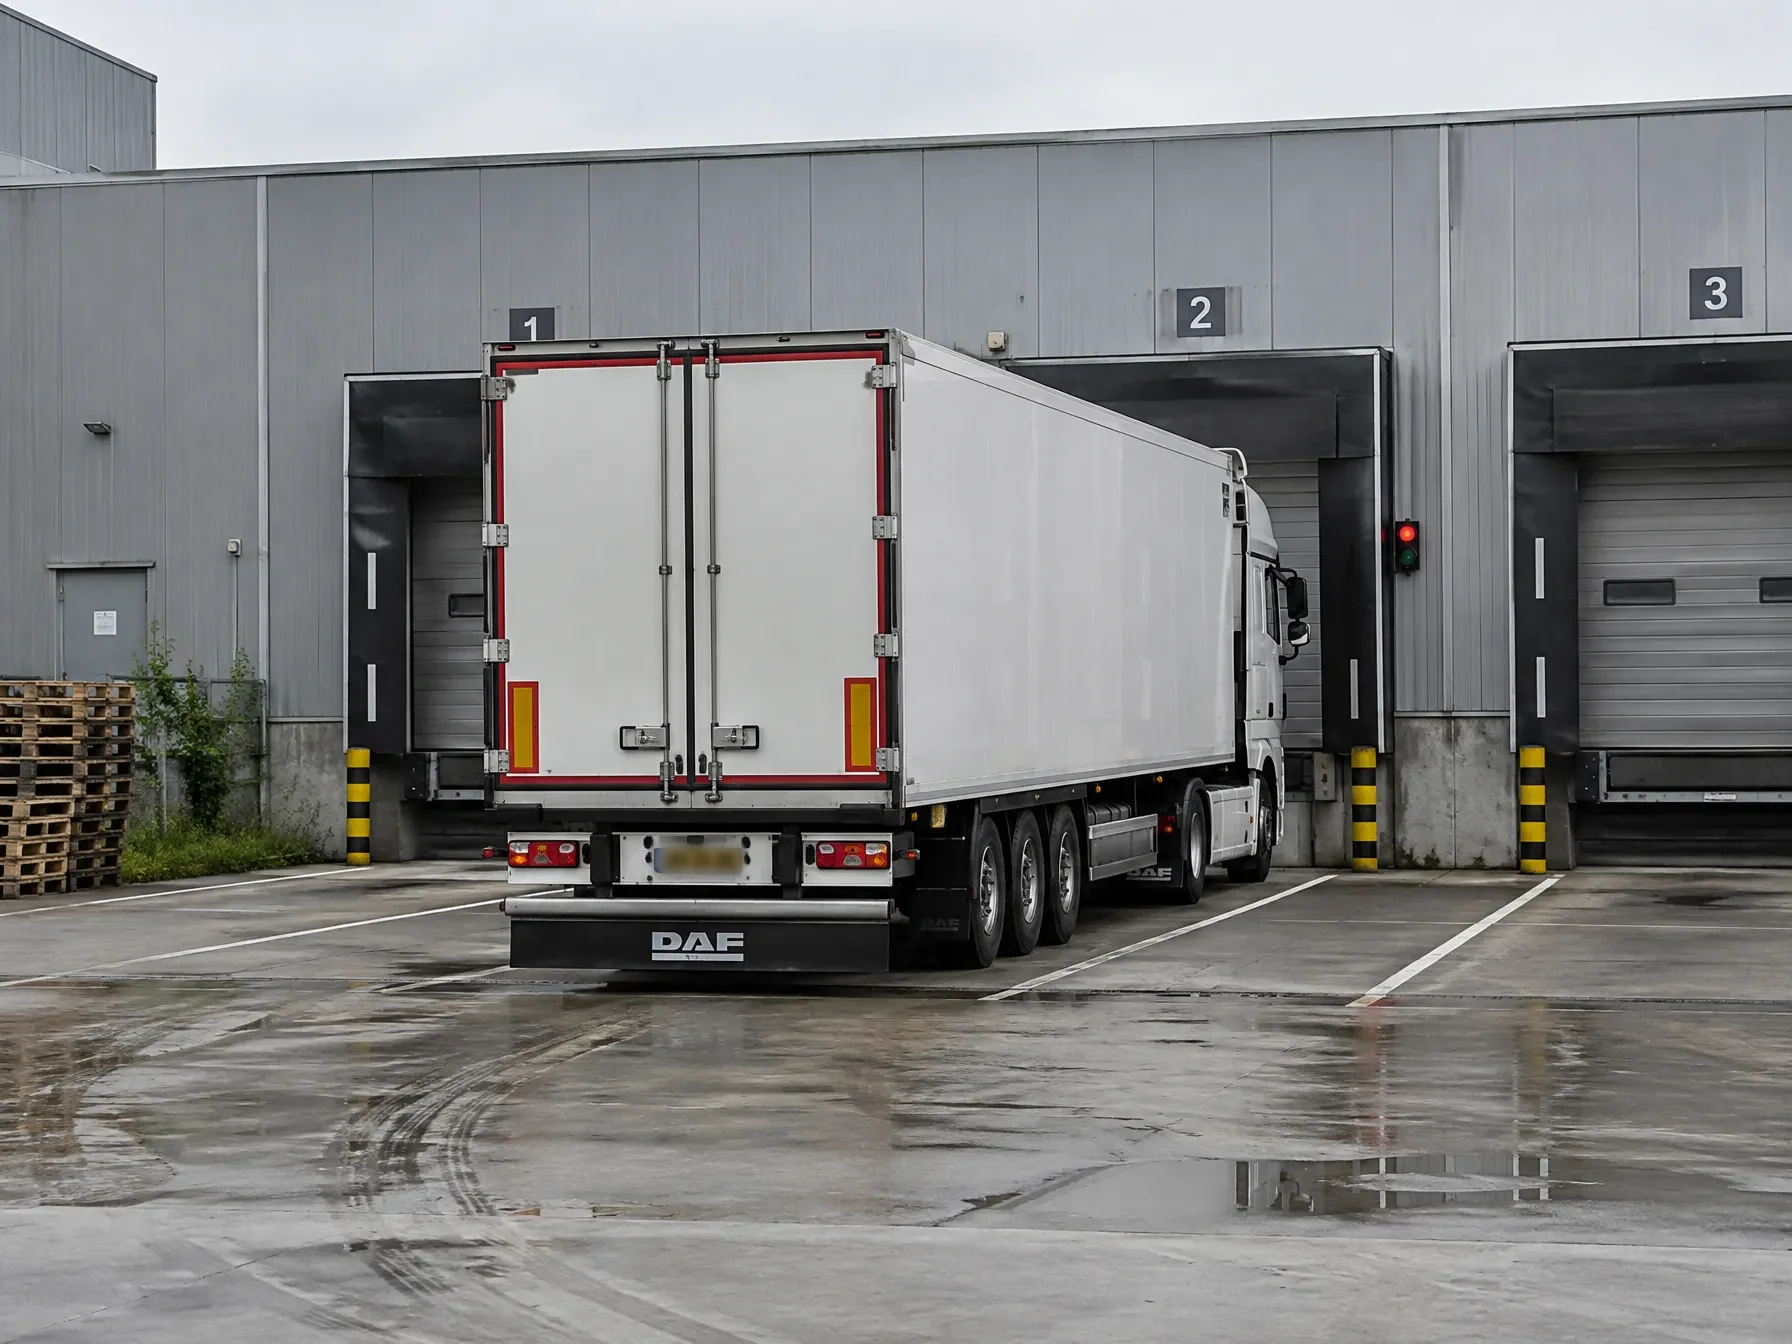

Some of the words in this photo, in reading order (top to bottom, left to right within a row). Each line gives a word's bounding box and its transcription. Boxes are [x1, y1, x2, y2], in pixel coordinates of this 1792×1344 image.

[1704, 276, 1728, 310] 3
[1190, 295, 1212, 329] 2
[524, 316, 537, 342] 1
[651, 931, 744, 952] DAF
